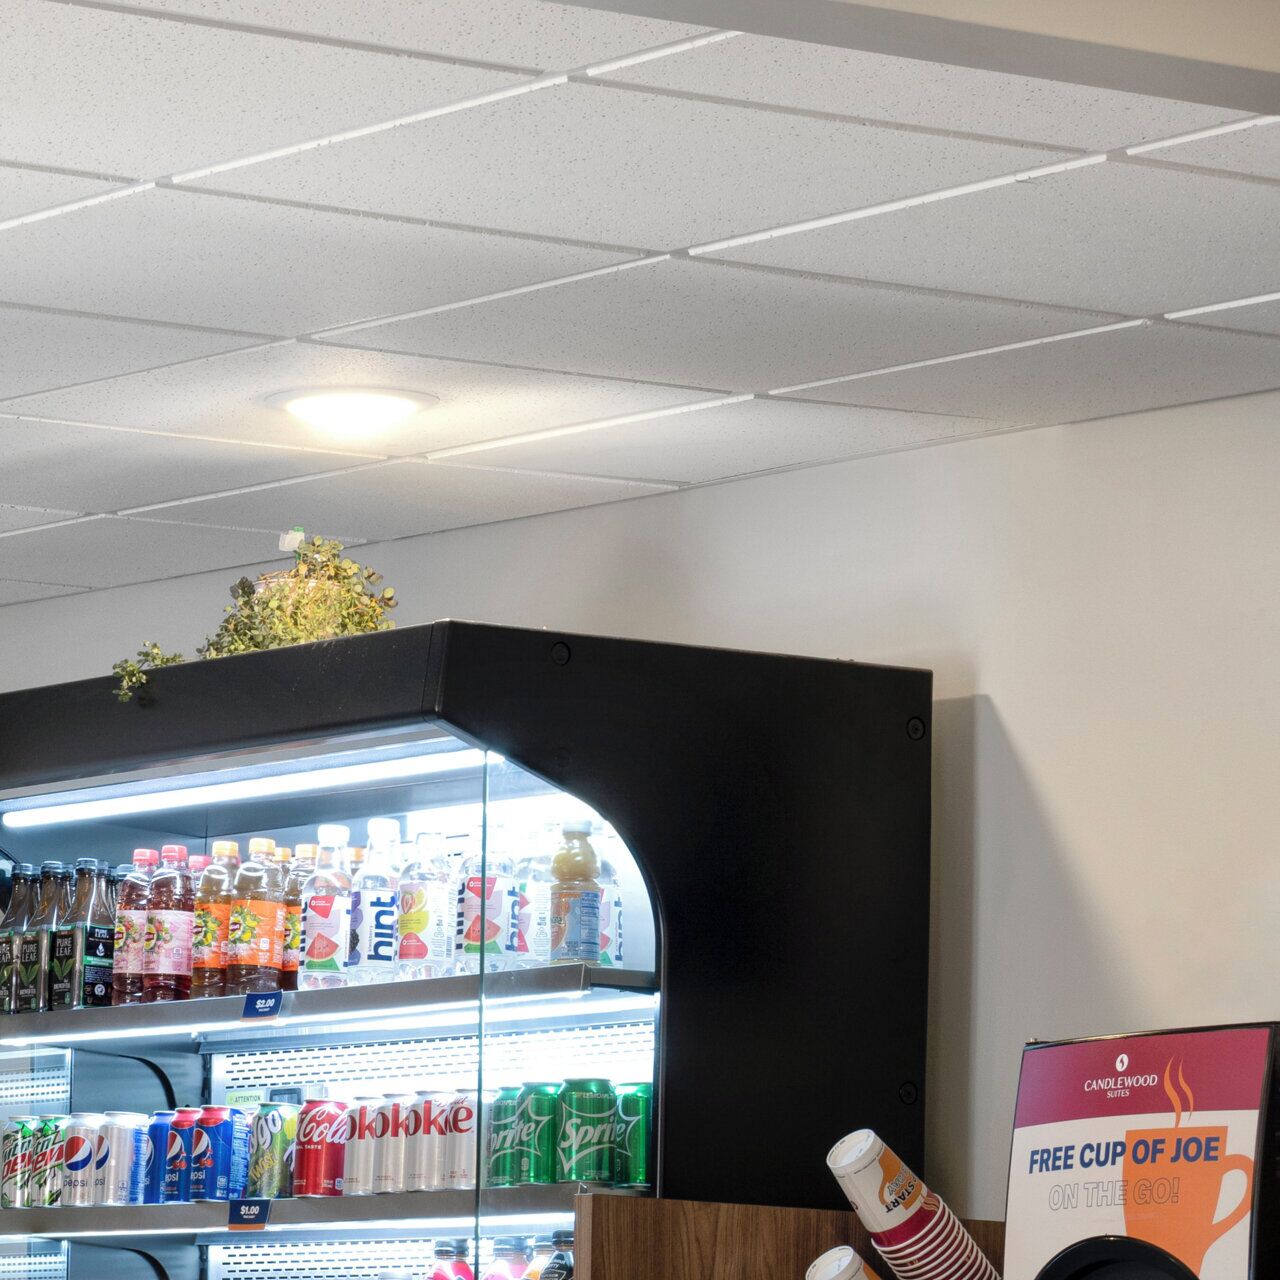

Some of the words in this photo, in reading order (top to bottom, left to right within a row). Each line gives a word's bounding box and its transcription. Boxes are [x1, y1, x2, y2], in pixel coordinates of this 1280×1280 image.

[367, 891, 398, 962] hint
[56, 938, 72, 947] PURE
[22, 943, 38, 953] PURE
[256, 999, 276, 1009] $2.00
[1084, 1074, 1158, 1091] CANDLEWOOD
[1106, 1089, 1130, 1098] SUITES
[235, 1095, 261, 1103] ATTENTION
[1028, 1145, 1075, 1174] FREE
[1079, 1141, 1127, 1169] CUP
[1132, 1138, 1166, 1165] OF
[1170, 1136, 1220, 1163] JOE
[63, 1178, 89, 1189] pepsi
[1048, 1181, 1079, 1211] ON
[1083, 1179, 1129, 1208] THE
[1132, 1176, 1181, 1206] GO!
[240, 1206, 259, 1215] $1.00
